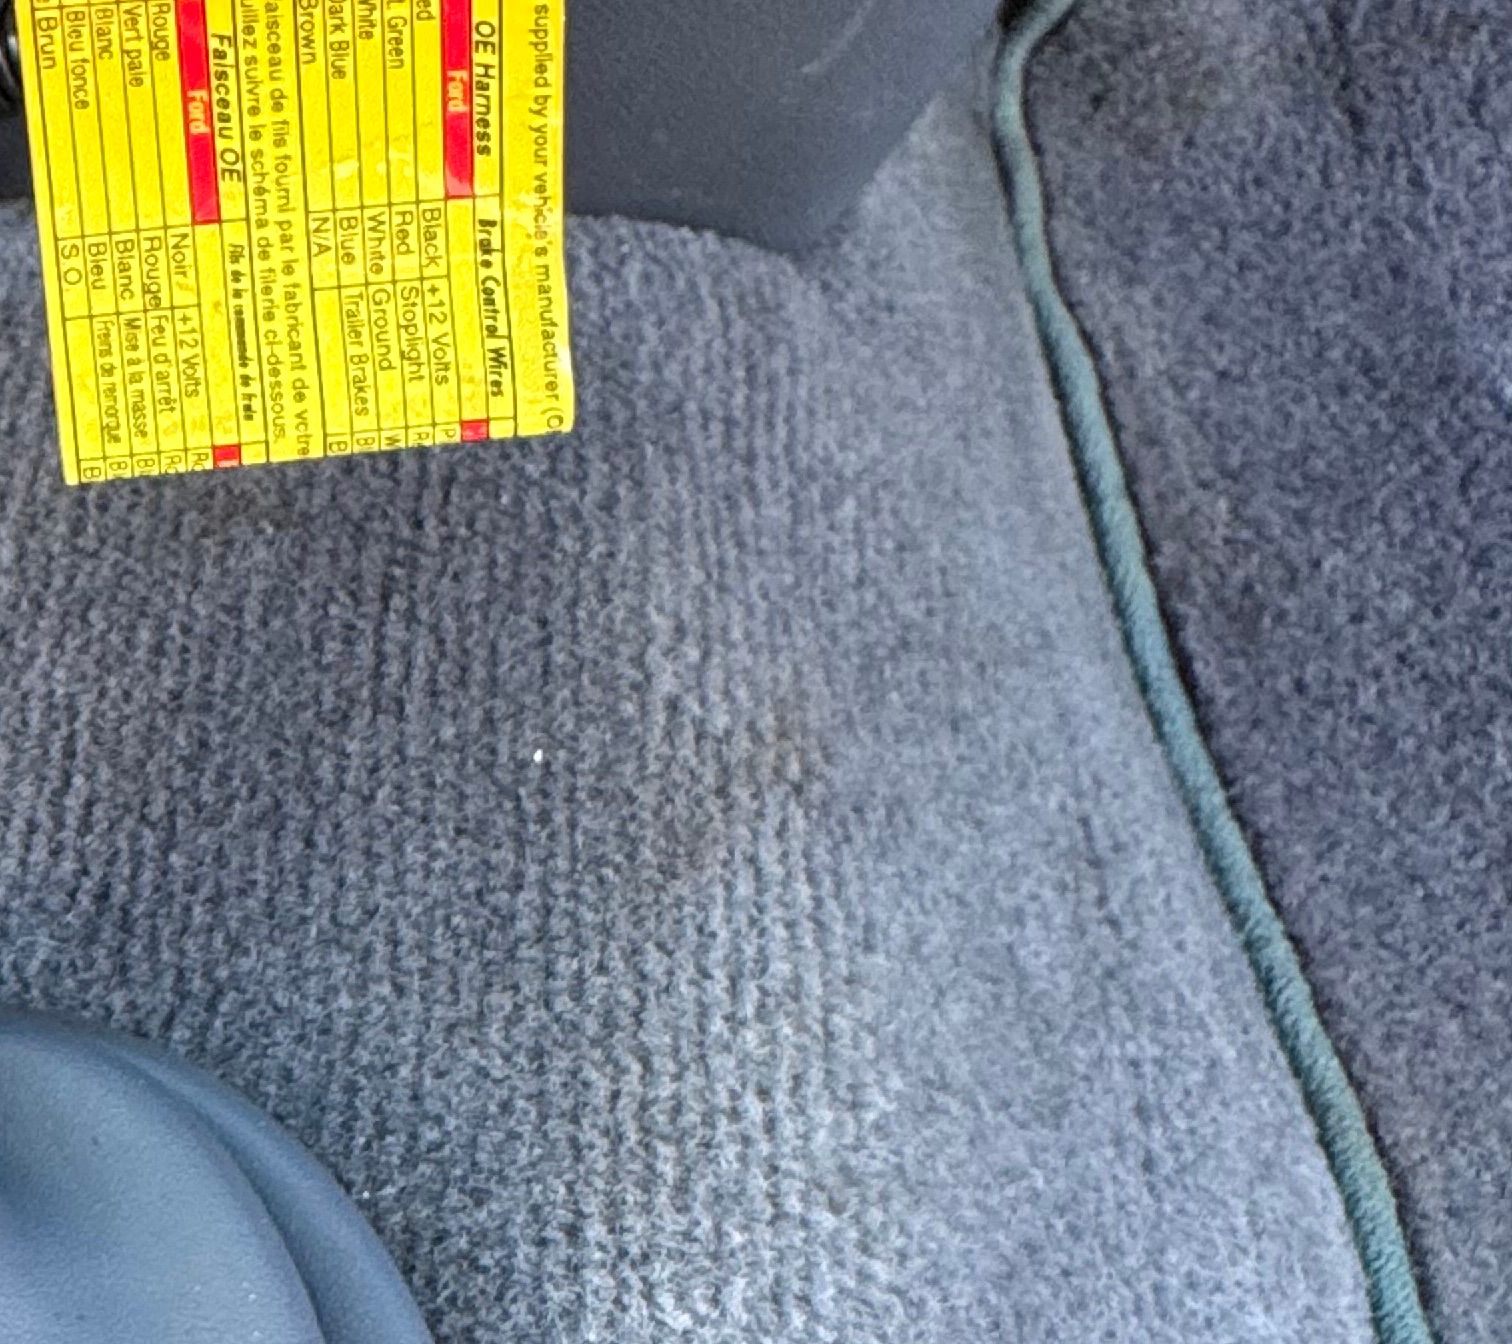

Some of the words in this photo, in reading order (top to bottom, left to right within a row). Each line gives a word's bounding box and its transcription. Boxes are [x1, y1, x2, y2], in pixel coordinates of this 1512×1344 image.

[38, 17, 58, 69] Brun
[66, 11, 86, 52] Bleu
[95, 9, 114, 60] Blanc
[123, 5, 144, 43] Vert
[151, 3, 171, 62] Rouge
[388, 17, 407, 69] Green
[475, 21, 495, 54] OE
[529, 4, 552, 88] supplied
[330, 40, 350, 79] Blue
[212, 34, 235, 139] Faisceau
[245, 56, 263, 116] suivre
[270, 89, 287, 112] de
[447, 70, 467, 112] Ford
[529, 94, 550, 117] by
[187, 89, 207, 135] Ford
[248, 125, 266, 141] le
[476, 64, 496, 156] Harness
[272, 120, 291, 148] fils
[529, 124, 548, 167] your
[221, 149, 241, 183] OE
[250, 149, 270, 229] schéma
[274, 155, 296, 213] fourni
[274, 221, 296, 253] par
[312, 217, 332, 257] N/A
[395, 211, 415, 255] Red
[423, 208, 442, 268] Black
[534, 173, 553, 257] vehicle's
[170, 233, 191, 278] Noir
[257, 237, 273, 261] de
[339, 217, 358, 265] Blue
[367, 212, 386, 274] White
[478, 219, 498, 269] Brake
[88, 243, 107, 290] Bleu
[115, 239, 135, 300] Blanc
[143, 236, 162, 307] Rouge
[282, 258, 299, 276] le
[259, 268, 278, 322] filerie
[427, 284, 447, 324] +12
[481, 276, 504, 338] Control
[96, 321, 115, 358] Freins
[124, 318, 142, 352] Mise
[150, 315, 169, 347] Feu
[178, 313, 198, 349] +12
[283, 283, 307, 371] fabricant
[344, 293, 364, 347] Trailer
[372, 289, 396, 372] Ground
[399, 287, 424, 383] Stoplight
[537, 265, 559, 400] manufacturer
[100, 363, 117, 377] de
[127, 358, 144, 366] à
[129, 371, 146, 384] la
[153, 353, 177, 414] d'arrêt
[182, 355, 201, 398] Volts
[432, 334, 451, 386] Volts
[487, 347, 507, 398] Wires
[264, 330, 286, 444] ci-dessous.
[292, 378, 309, 403] de
[350, 354, 369, 416] Brakes
[103, 383, 122, 444] remorque
[131, 390, 149, 438] masse
[295, 410, 312, 455] votre
[415, 433, 429, 446] R
